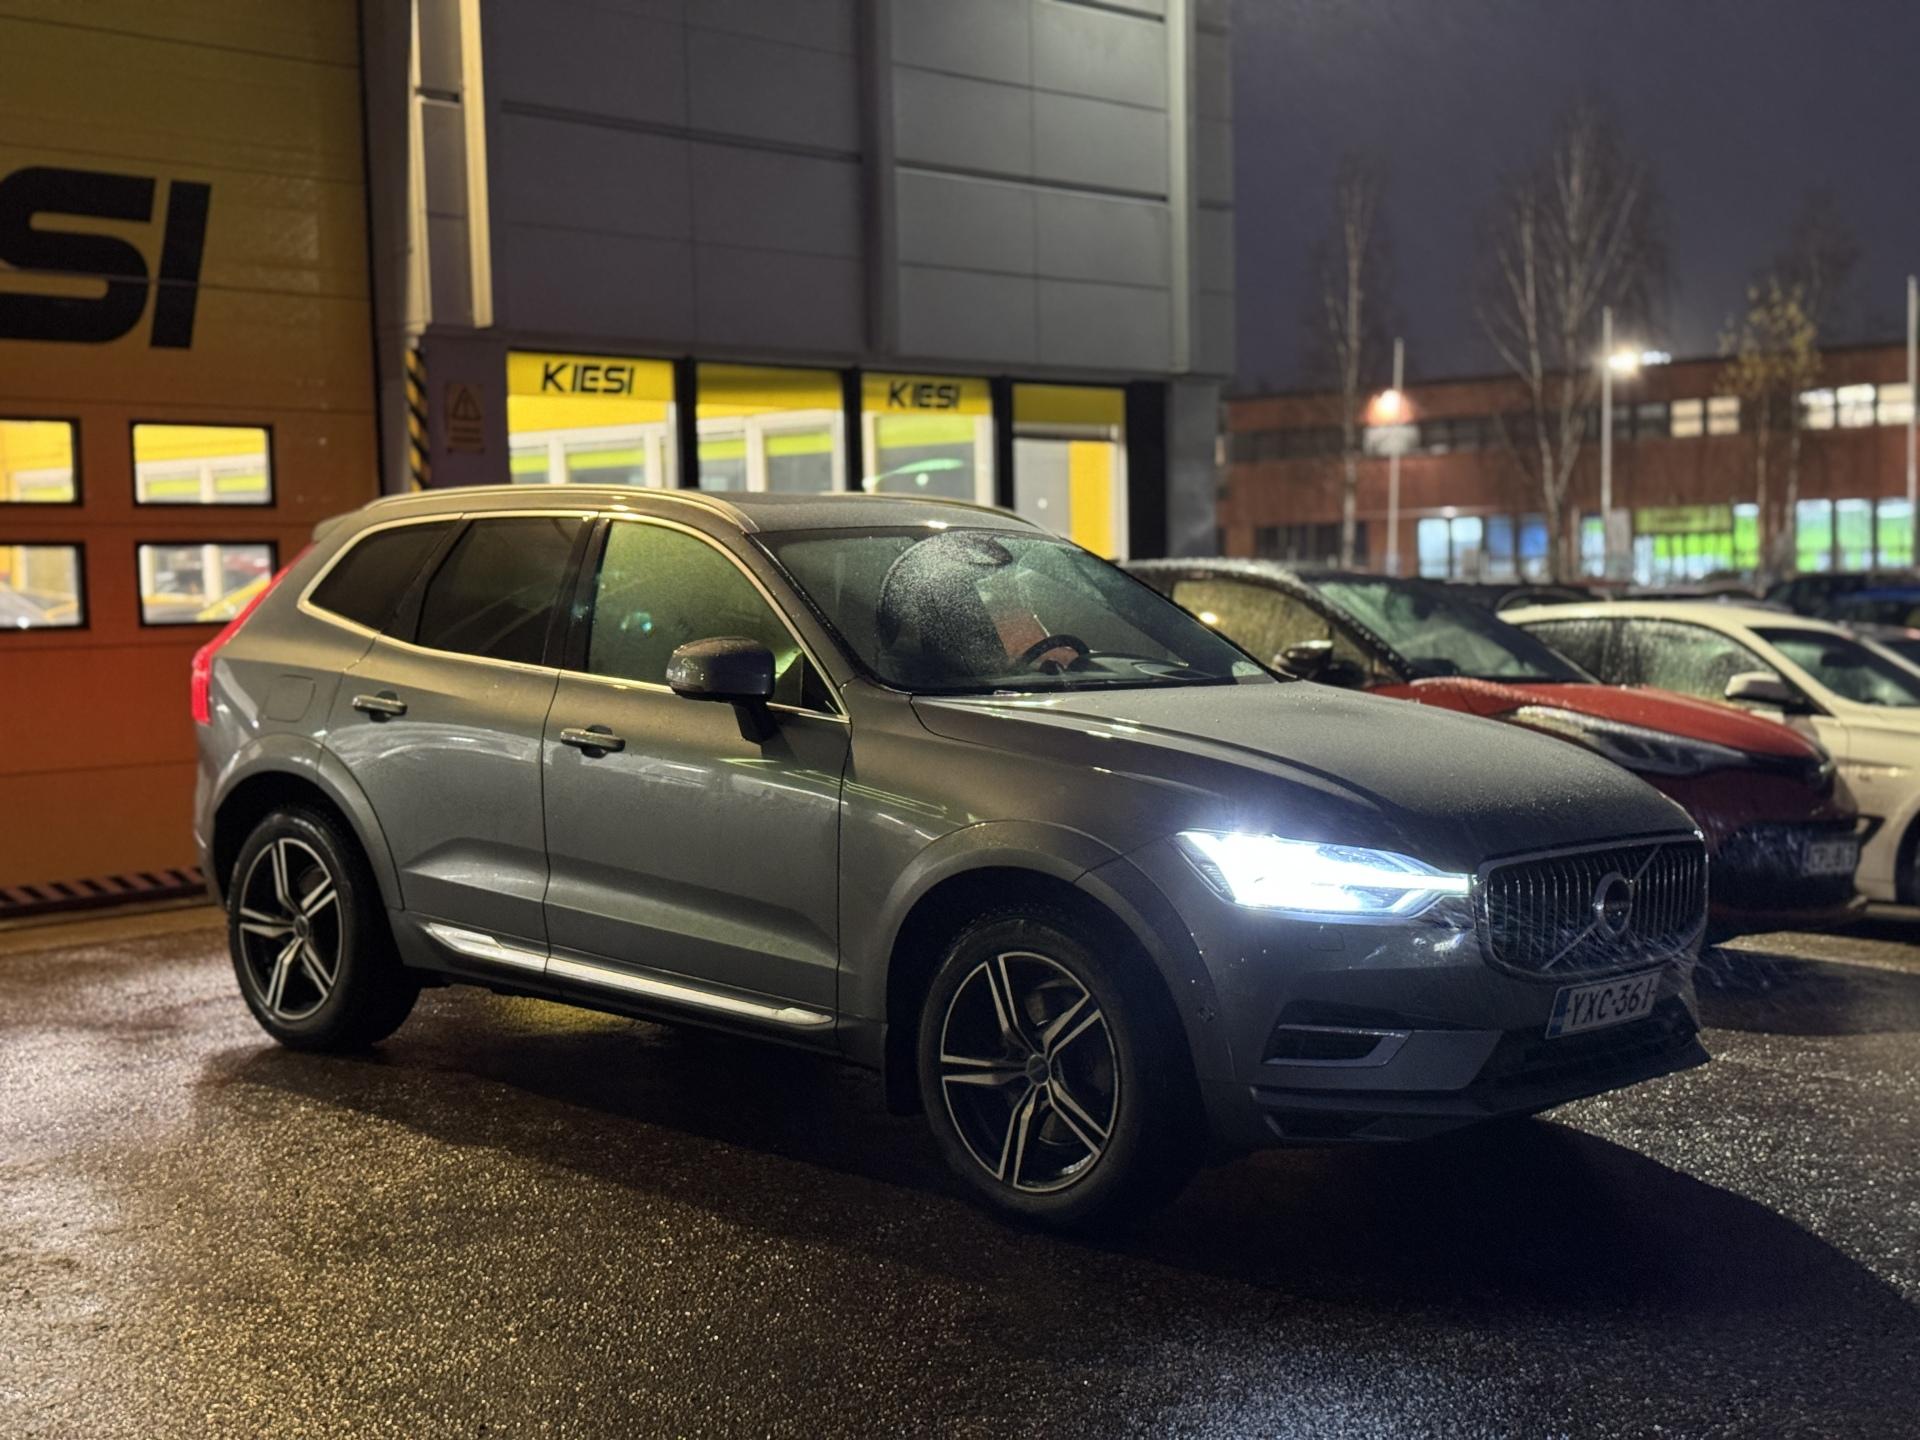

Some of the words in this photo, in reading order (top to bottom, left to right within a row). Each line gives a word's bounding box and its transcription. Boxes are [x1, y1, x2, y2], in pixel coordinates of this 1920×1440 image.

[541, 362, 635, 395] KIESI
[887, 380, 961, 409] KIESI
[1571, 978, 1653, 1026] YXC-361
